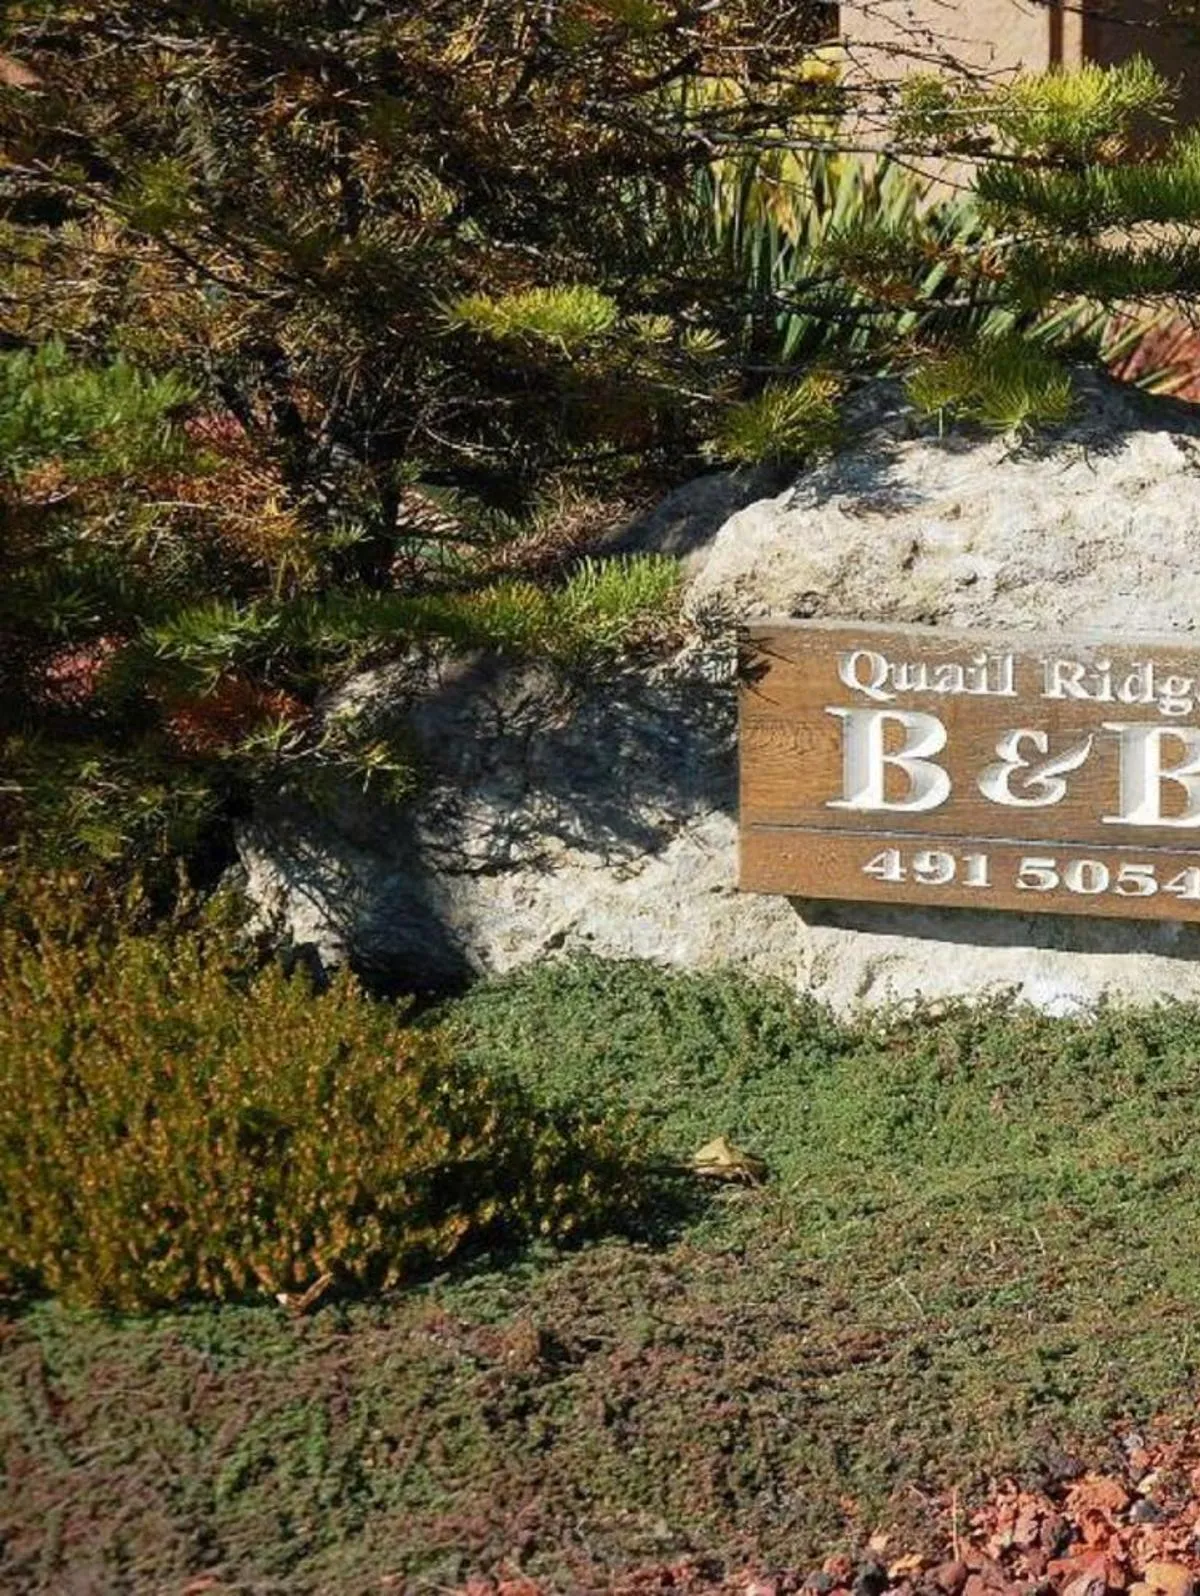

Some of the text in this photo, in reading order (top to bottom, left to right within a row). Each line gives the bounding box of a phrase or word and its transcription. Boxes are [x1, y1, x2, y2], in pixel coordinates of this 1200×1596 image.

[838, 650, 1017, 701] Quail
[825, 706, 952, 812] B
[978, 729, 1094, 807] &
[862, 848, 992, 888] 491
